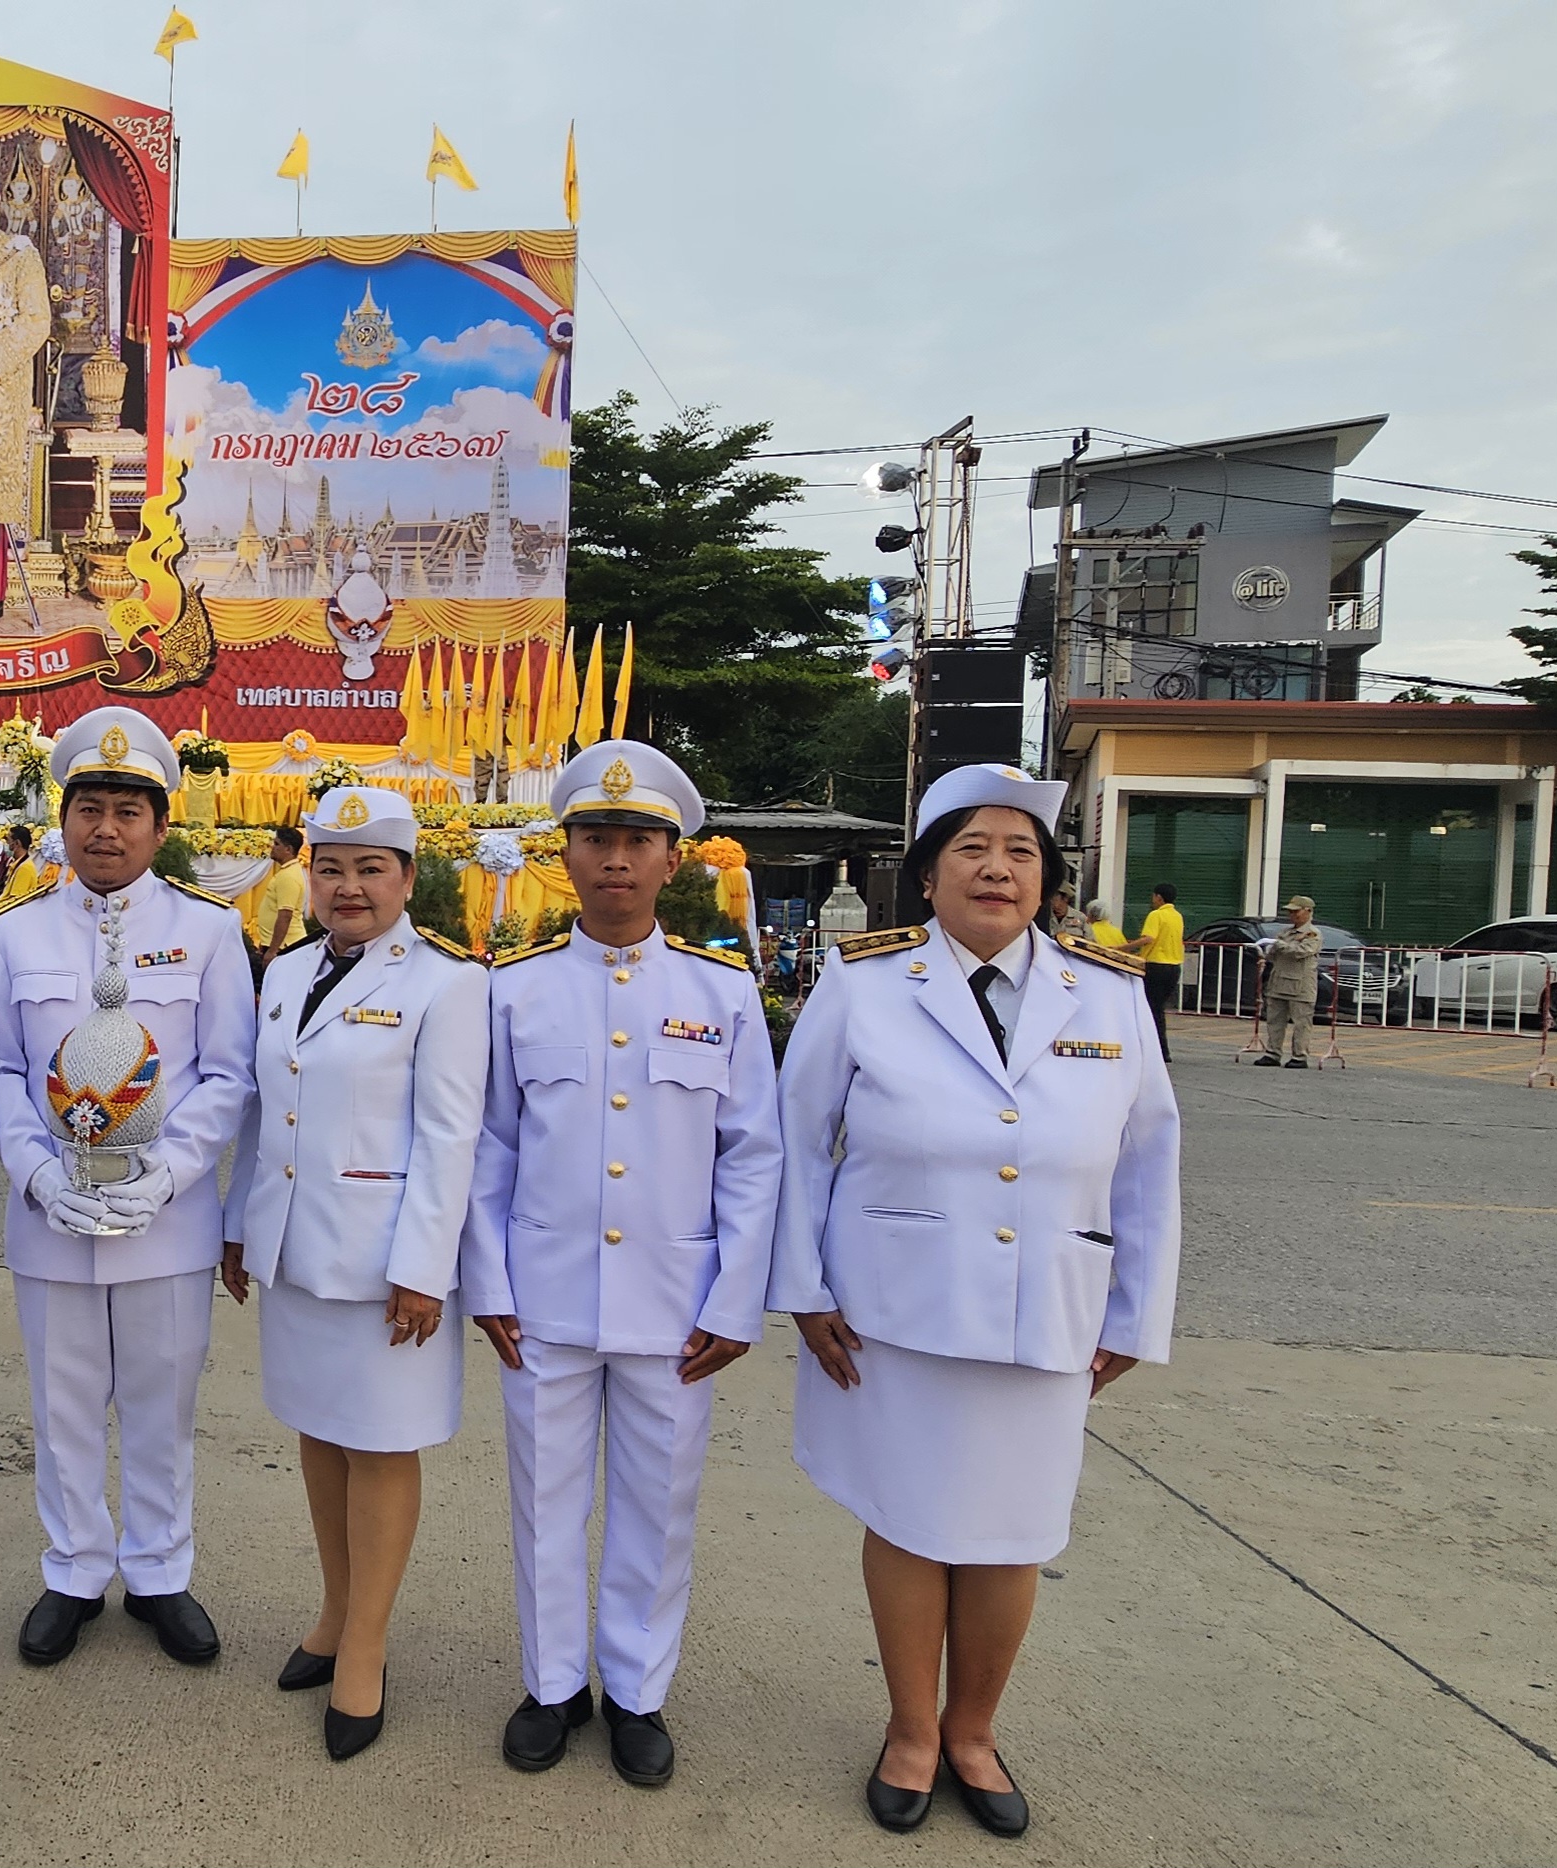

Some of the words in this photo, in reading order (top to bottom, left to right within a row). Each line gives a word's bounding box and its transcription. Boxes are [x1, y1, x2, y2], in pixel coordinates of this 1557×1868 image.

[301, 372, 420, 416] ๒๘
[210, 432, 363, 467] กรกฎาคม
[368, 429, 511, 459] ๒๕๖๗
